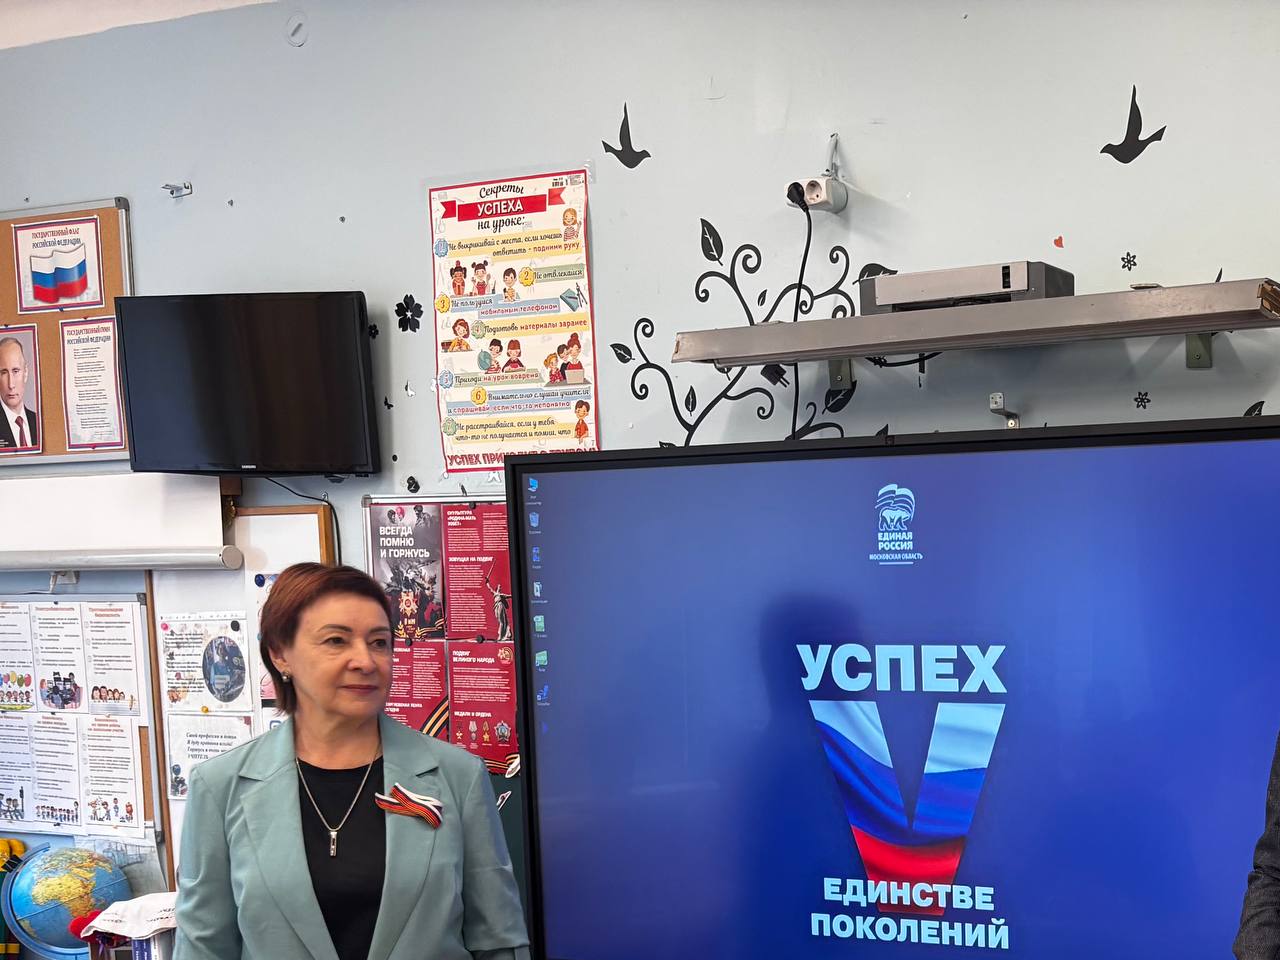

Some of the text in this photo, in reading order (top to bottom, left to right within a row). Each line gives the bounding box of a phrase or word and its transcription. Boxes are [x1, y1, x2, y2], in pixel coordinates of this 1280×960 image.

[479, 184, 524, 198] Секреты
[477, 199, 523, 216] УСПЕХА
[477, 216, 525, 233] на уроке:
[492, 242, 580, 256] ответить подними руку
[519, 321, 558, 331] материалы
[559, 319, 588, 328] заранее
[493, 374, 509, 383] урок
[510, 373, 539, 381] вовремя
[447, 453, 481, 466] УСПЕХ
[379, 526, 413, 537] ВСЕГДА
[878, 532, 913, 541] ЕДИНАЯ
[380, 537, 414, 547] ПОМНЮ
[878, 541, 913, 551] РОССИЯ
[380, 549, 430, 558] И ГОРЖУСЬ
[796, 643, 1008, 693] УСПЕХ
[823, 877, 995, 911] ЕДИНСТВЕ
[810, 912, 1009, 950] ПОКОЛЕНИЙ
